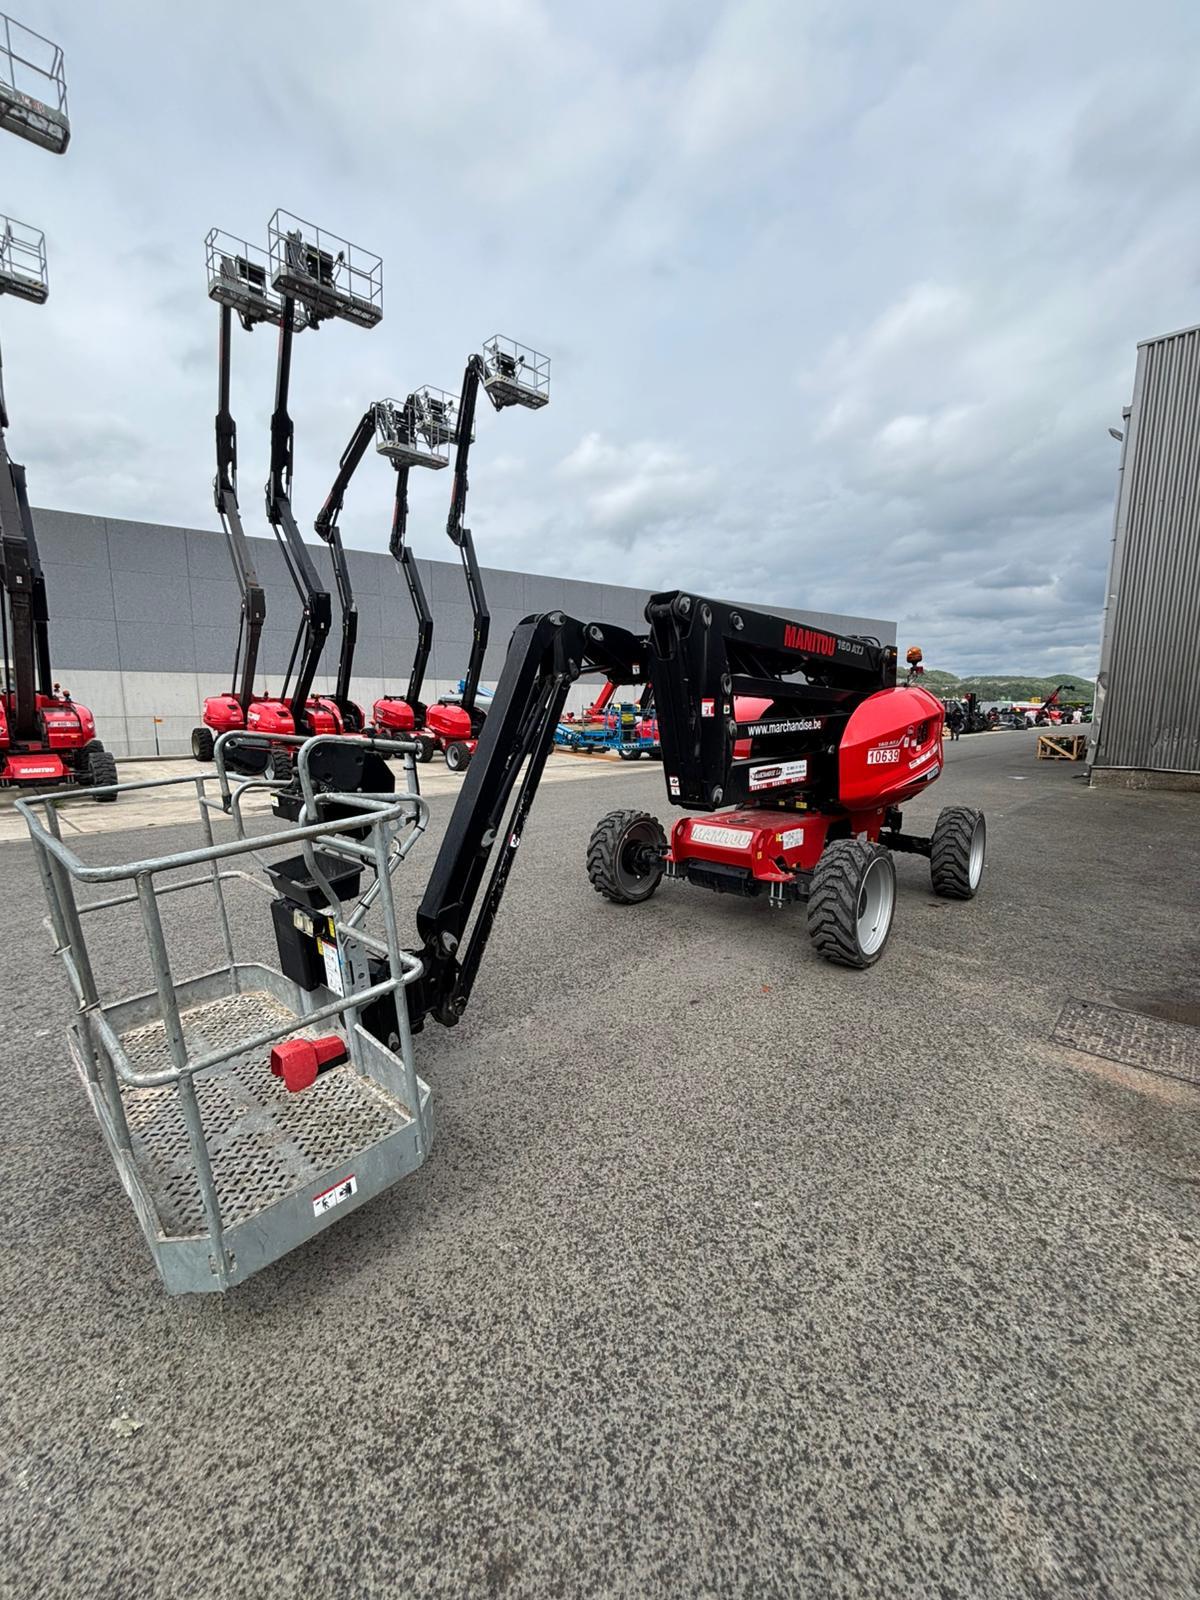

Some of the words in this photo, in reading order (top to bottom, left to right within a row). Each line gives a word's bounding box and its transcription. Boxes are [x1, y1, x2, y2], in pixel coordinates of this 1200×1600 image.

[784, 624, 835, 656] MANITOU
[748, 718, 821, 735] www.marchandise.be
[869, 750, 899, 763] 10639
